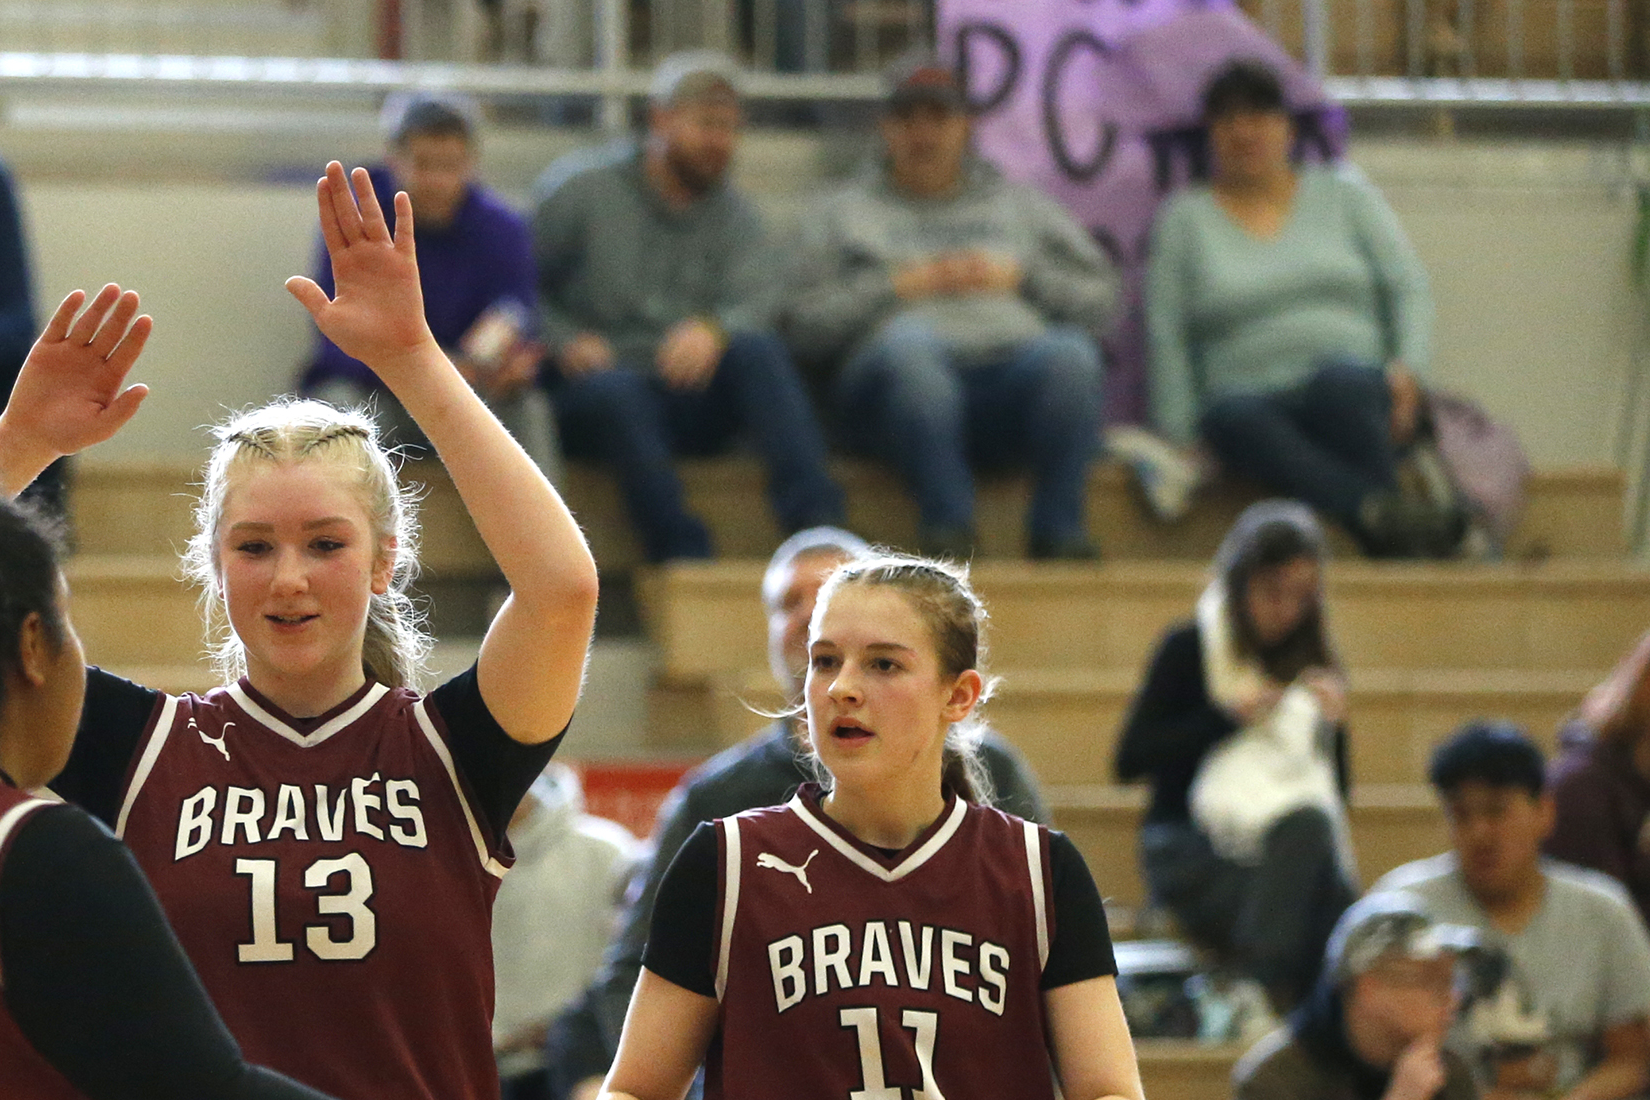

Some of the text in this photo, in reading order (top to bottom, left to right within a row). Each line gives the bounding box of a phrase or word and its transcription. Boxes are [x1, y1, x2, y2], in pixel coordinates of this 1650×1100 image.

[174, 771, 428, 862] BRAVES
[234, 851, 378, 964] 13
[767, 920, 1011, 1017] BRAVES
